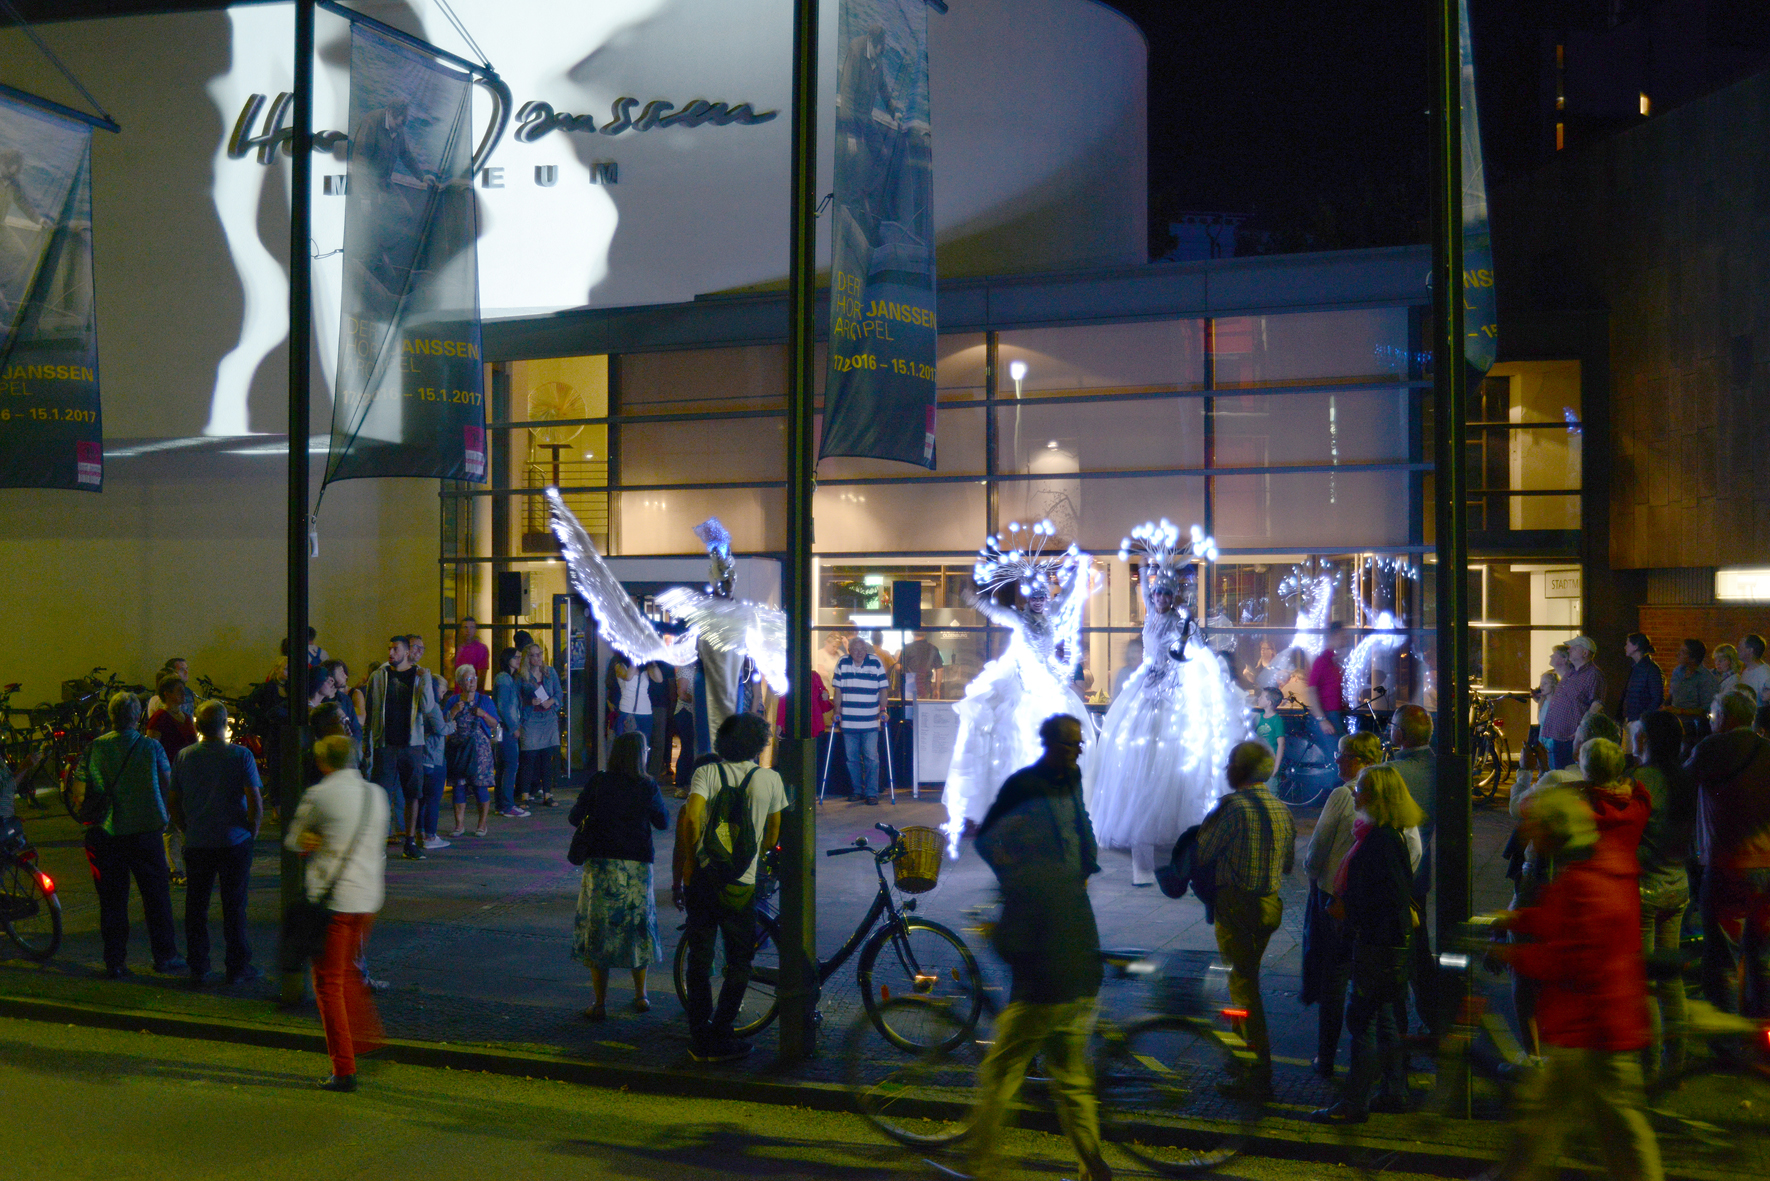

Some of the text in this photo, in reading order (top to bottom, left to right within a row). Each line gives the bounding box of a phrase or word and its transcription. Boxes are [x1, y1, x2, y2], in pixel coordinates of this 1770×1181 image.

[324, 162, 618, 196] MEUM
[838, 271, 860, 297] DER
[836, 294, 937, 331] HOR JANSSEN
[348, 317, 378, 339] DER
[389, 338, 480, 360] JANSSEN
[2, 364, 94, 382] JANSSEN
[418, 387, 482, 406] 15.1.2017
[29, 407, 96, 423] 15.1.2017
[1551, 578, 1580, 590] STADTM
